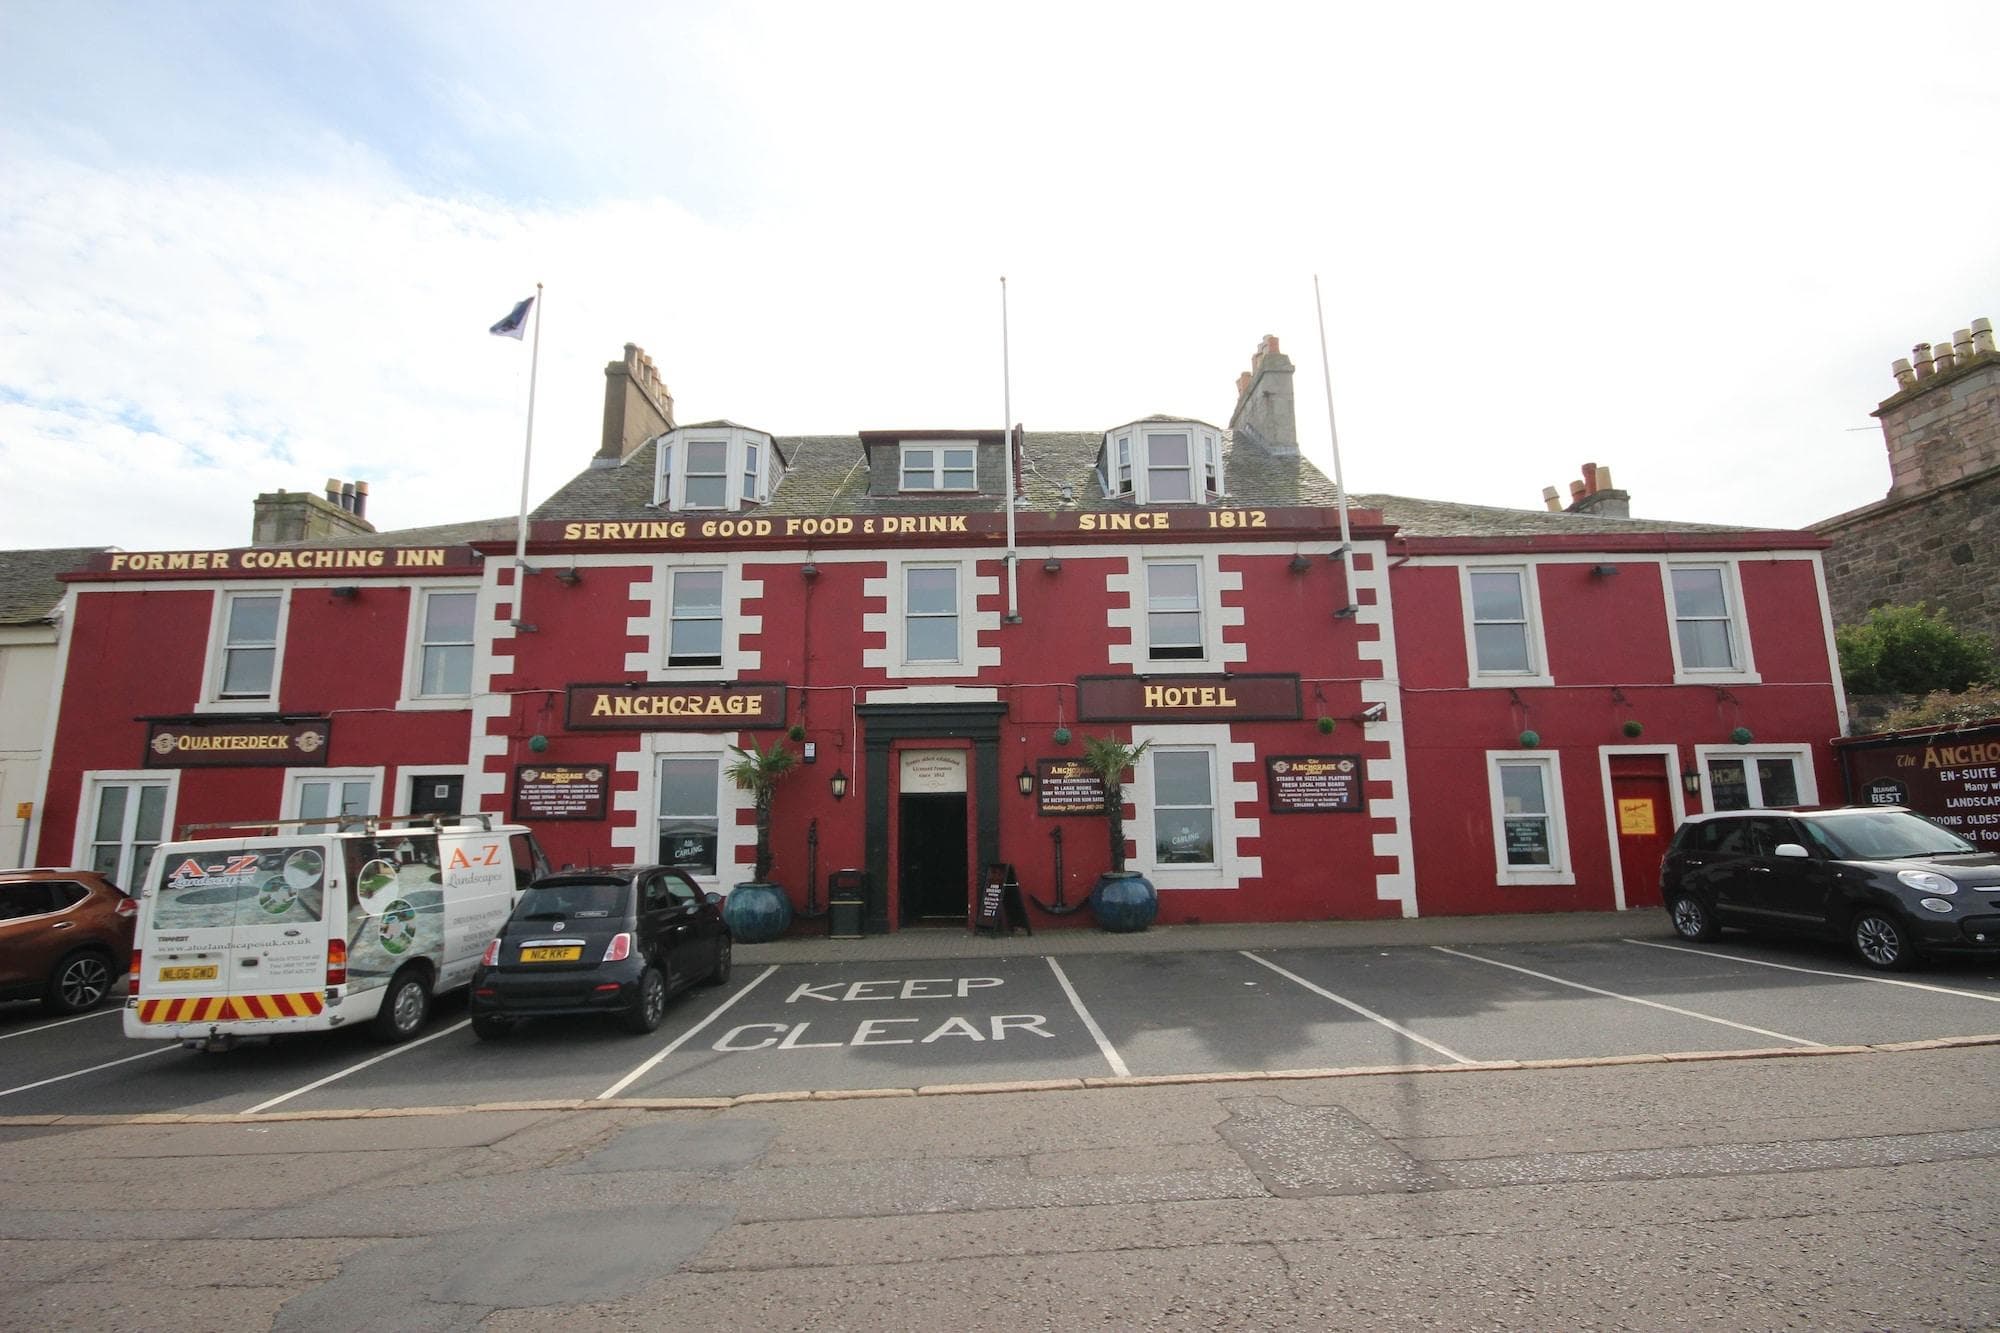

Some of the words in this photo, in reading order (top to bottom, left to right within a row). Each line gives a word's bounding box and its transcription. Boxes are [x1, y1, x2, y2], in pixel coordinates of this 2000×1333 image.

[564, 522, 685, 540] SERVING
[702, 520, 772, 537] GOOD
[786, 518, 854, 535] FOOD
[863, 521, 875, 533] &
[881, 515, 968, 533] DRINK
[1079, 512, 1169, 530] SINCE
[1209, 511, 1267, 528] 1812
[111, 552, 229, 570] FORMER
[241, 550, 383, 568] COACHING
[396, 549, 446, 566] INN
[591, 694, 762, 716] ANCHORAGE
[1144, 686, 1237, 708] HOTEL
[178, 735, 289, 750] QUARTERDECK
[1896, 754, 1917, 766] The
[1940, 767, 1997, 781] EN-SUITE
[1964, 781, 1988, 792] Many
[1871, 793, 1901, 803] BEST
[448, 845, 501, 869] A-Z
[674, 845, 704, 858] CARLING
[168, 855, 260, 878] A-Z
[785, 977, 1005, 1003] KEEP
[712, 1014, 1056, 1051] CLEAR
